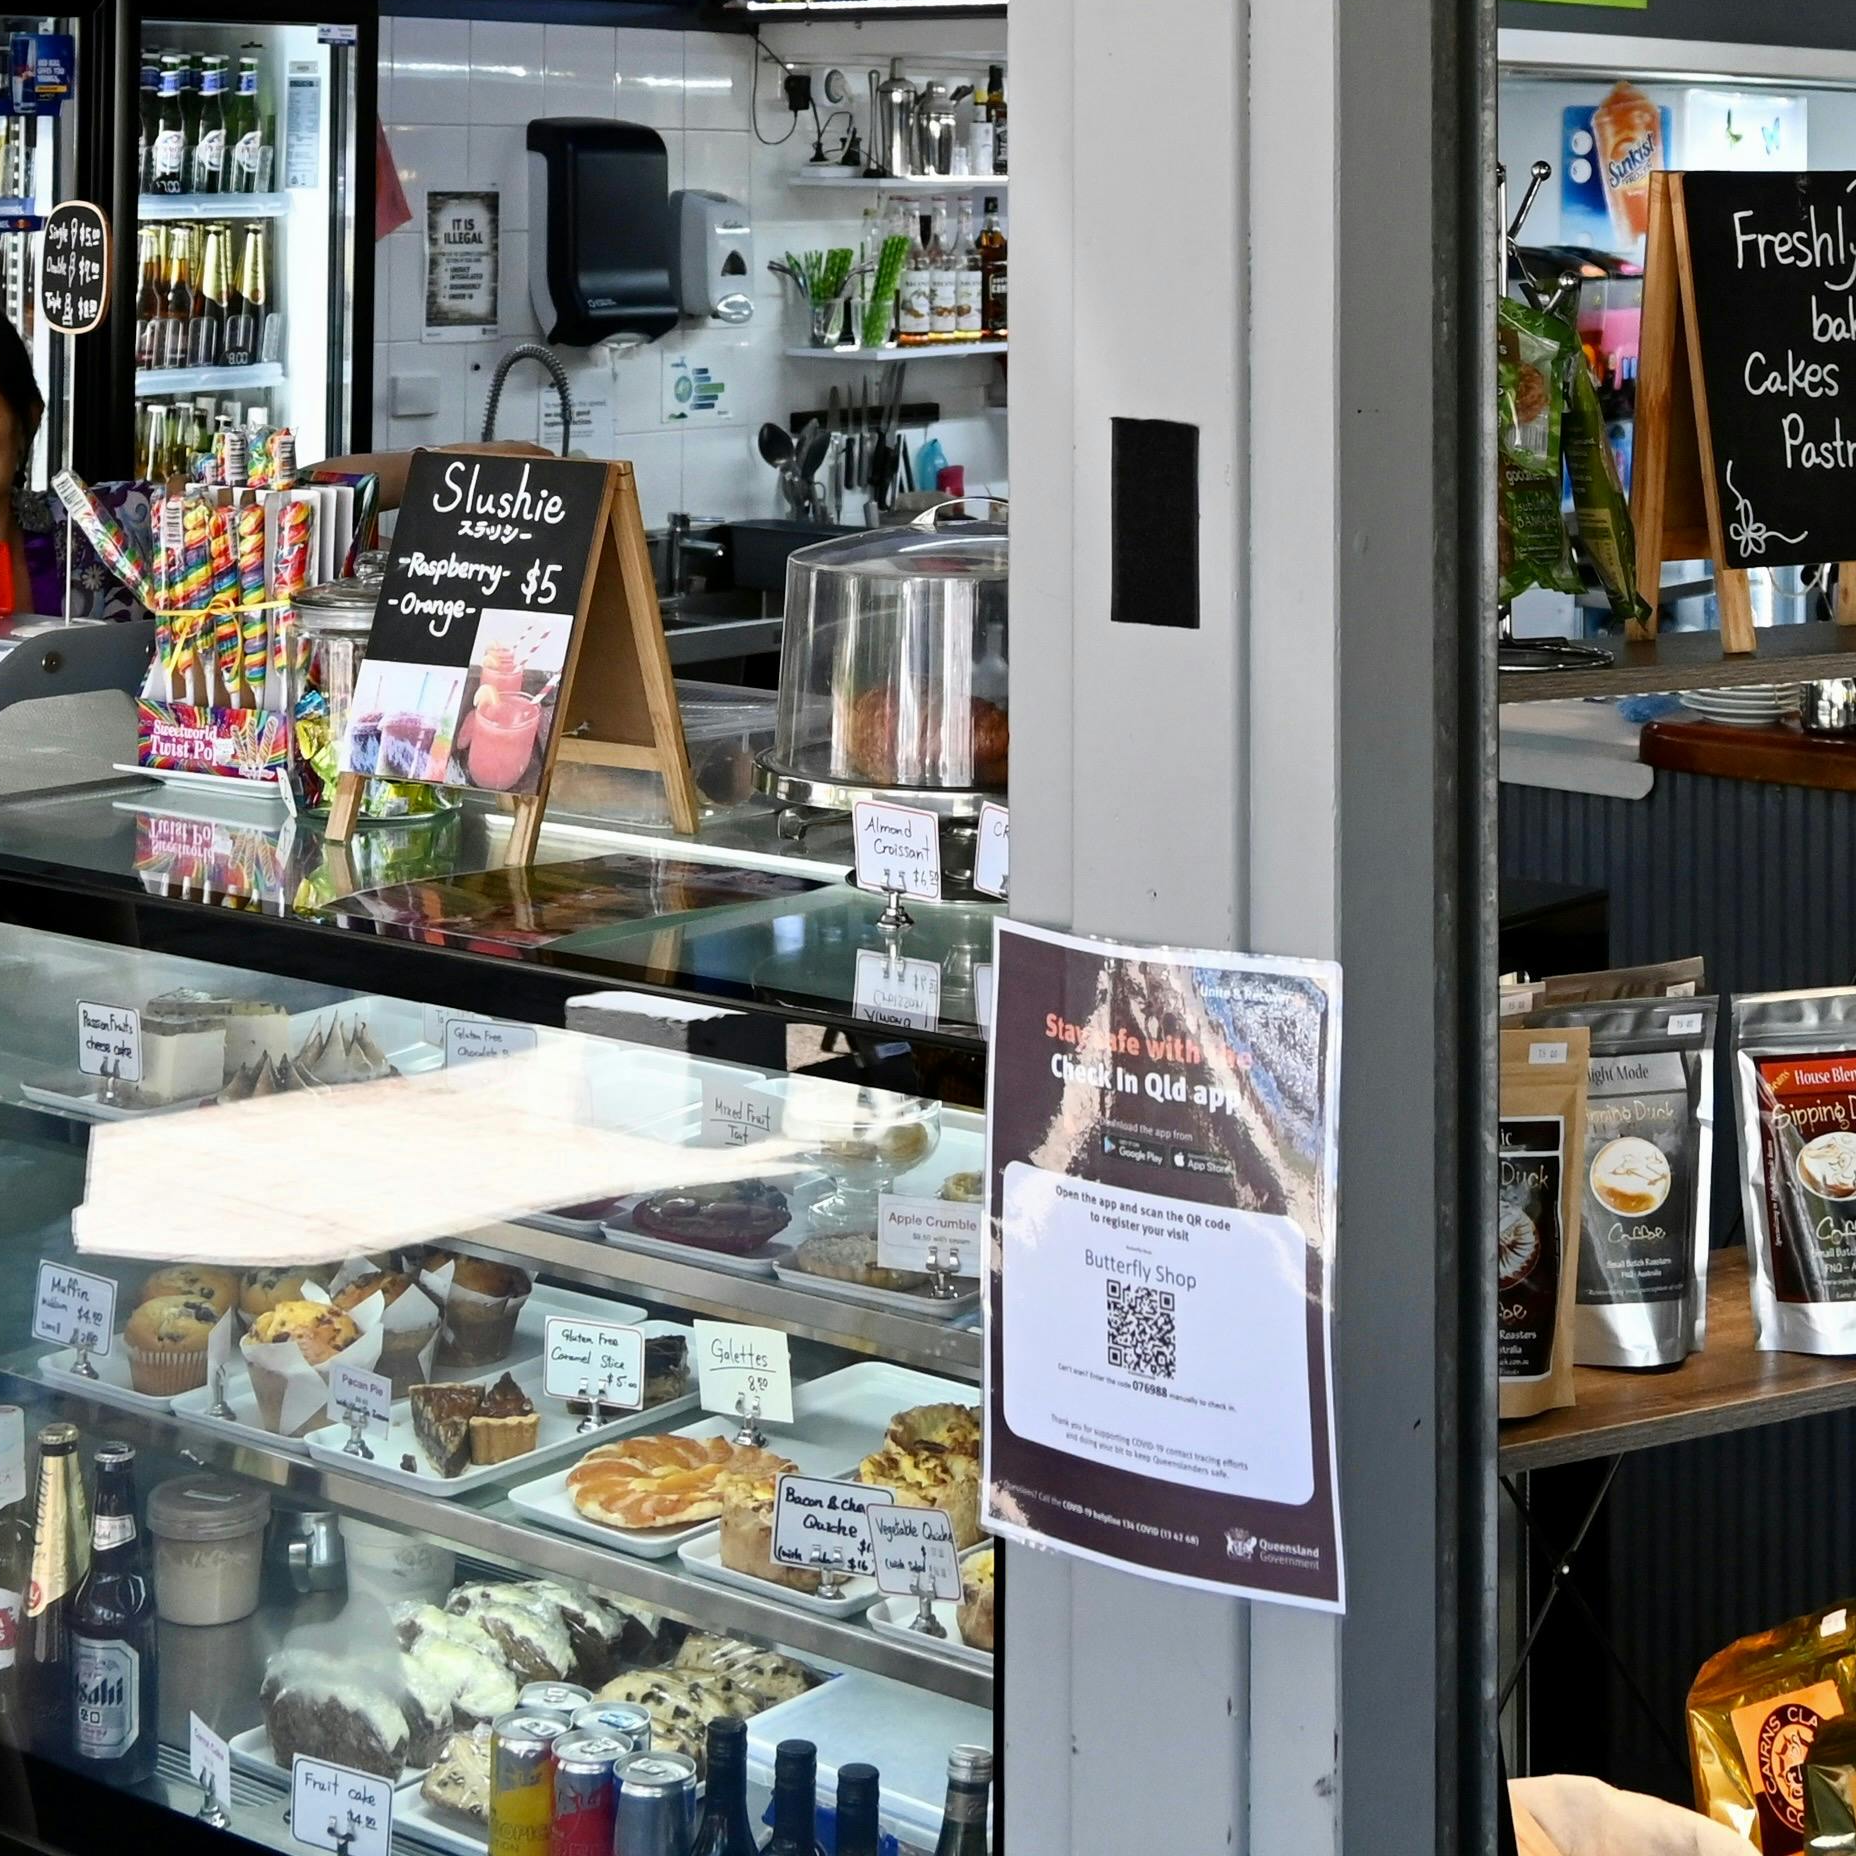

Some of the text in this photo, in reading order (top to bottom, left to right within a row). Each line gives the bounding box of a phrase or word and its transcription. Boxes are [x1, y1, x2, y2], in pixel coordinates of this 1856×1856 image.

[1608, 134, 1657, 187] Sunkist
[452, 219, 474, 231] IT IS
[445, 233, 482, 245] ILLEGAL
[1744, 350, 1839, 398] Cakes
[433, 461, 566, 524] Slushie
[458, 521, 532, 544] スラッシー
[521, 559, 562, 605] $5
[153, 720, 217, 741] Sweetworld
[150, 734, 189, 759] Twist
[865, 816, 912, 838] Almond
[874, 836, 930, 860] Croissant
[1147, 1035, 1201, 1064] with
[1050, 1052, 1241, 1115] Check In Qld app
[1794, 1070, 1830, 1085] House
[1771, 1099, 1850, 1132] Sipping
[1118, 1146, 1163, 1166] Google Play
[1055, 1185, 1231, 1231] Open the app and scan the QR code
[888, 1212, 977, 1232] Apple Crumble
[1090, 1211, 1189, 1242] to register your visit
[1085, 1249, 1197, 1292] Butterfly Shop
[562, 1329, 618, 1346] Gluten Free
[711, 1338, 769, 1368] Galettes
[1132, 1380, 1168, 1398] 076988
[1259, 1538, 1320, 1557] Queensland
[1259, 1552, 1320, 1570] Government
